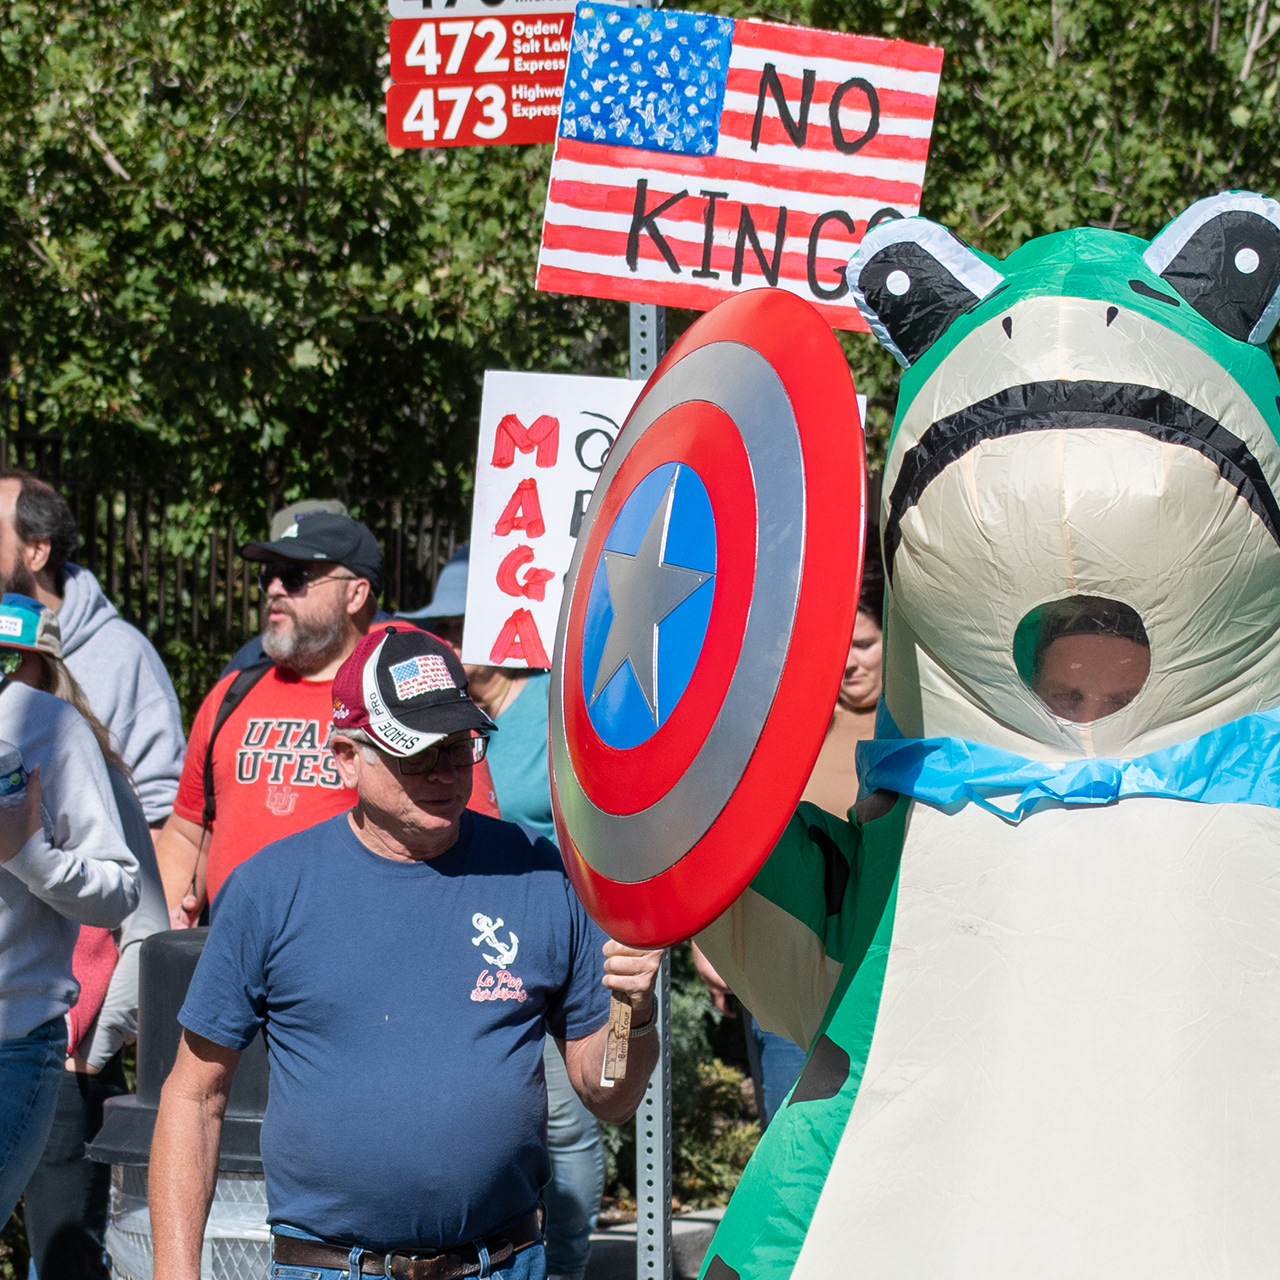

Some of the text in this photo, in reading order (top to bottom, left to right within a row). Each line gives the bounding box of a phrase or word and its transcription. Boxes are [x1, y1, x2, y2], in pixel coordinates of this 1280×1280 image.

[512, 19, 565, 38] Ogden/
[405, 18, 510, 75] 472
[513, 37, 570, 54] Salt Lak
[514, 58, 566, 74] Express
[511, 84, 563, 102] Highwa
[402, 84, 508, 141] 473
[512, 103, 562, 119] Express
[750, 62, 881, 155] NO
[626, 178, 908, 300] KING
[369, 692, 420, 750] SHADE PRO
[235, 748, 344, 790] UTES
[476, 969, 524, 990] La Paz
[620, 1011, 630, 1032] Your
